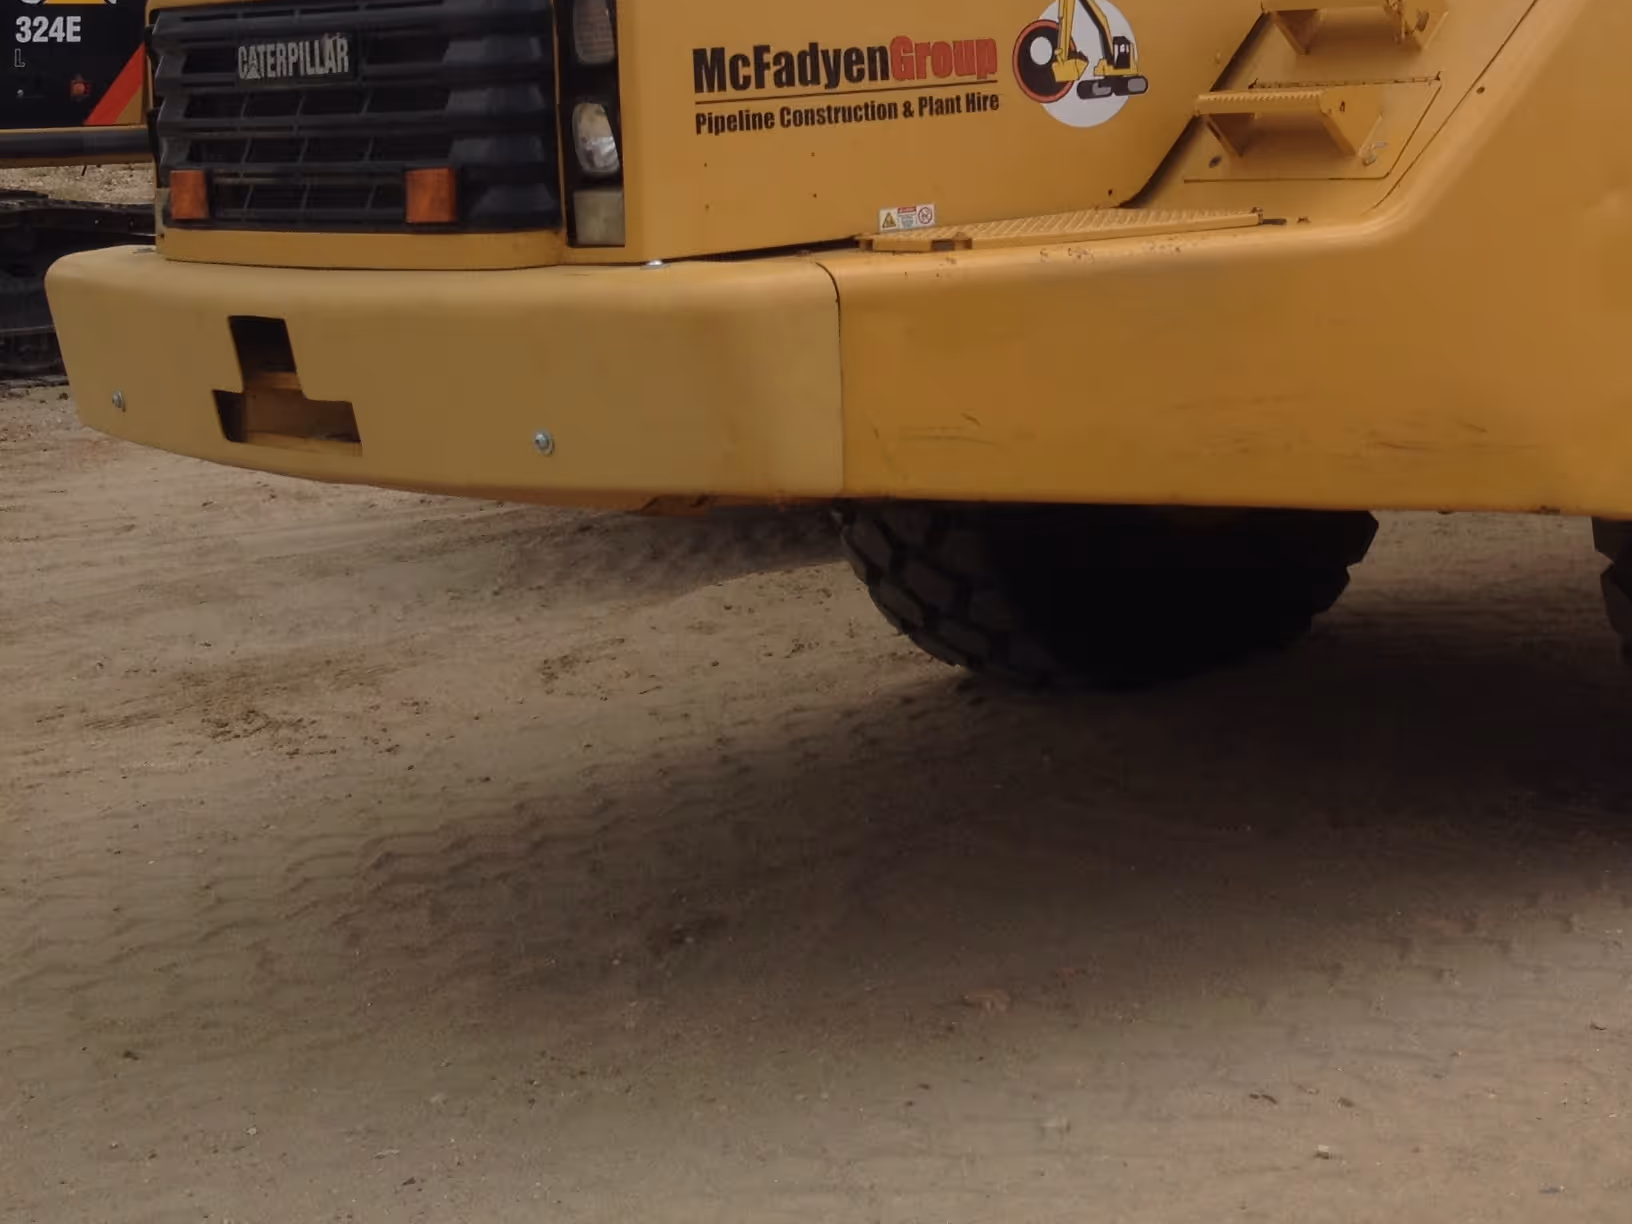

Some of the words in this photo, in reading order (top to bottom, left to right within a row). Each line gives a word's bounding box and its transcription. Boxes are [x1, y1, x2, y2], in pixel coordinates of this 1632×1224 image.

[15, 16, 81, 43] 324E
[238, 36, 349, 80] CATERPILLAR
[695, 110, 775, 136] Pipeline
[780, 101, 898, 128] Construction
[903, 100, 915, 118] &
[918, 94, 962, 117] Plant
[965, 92, 1000, 113] Hire
